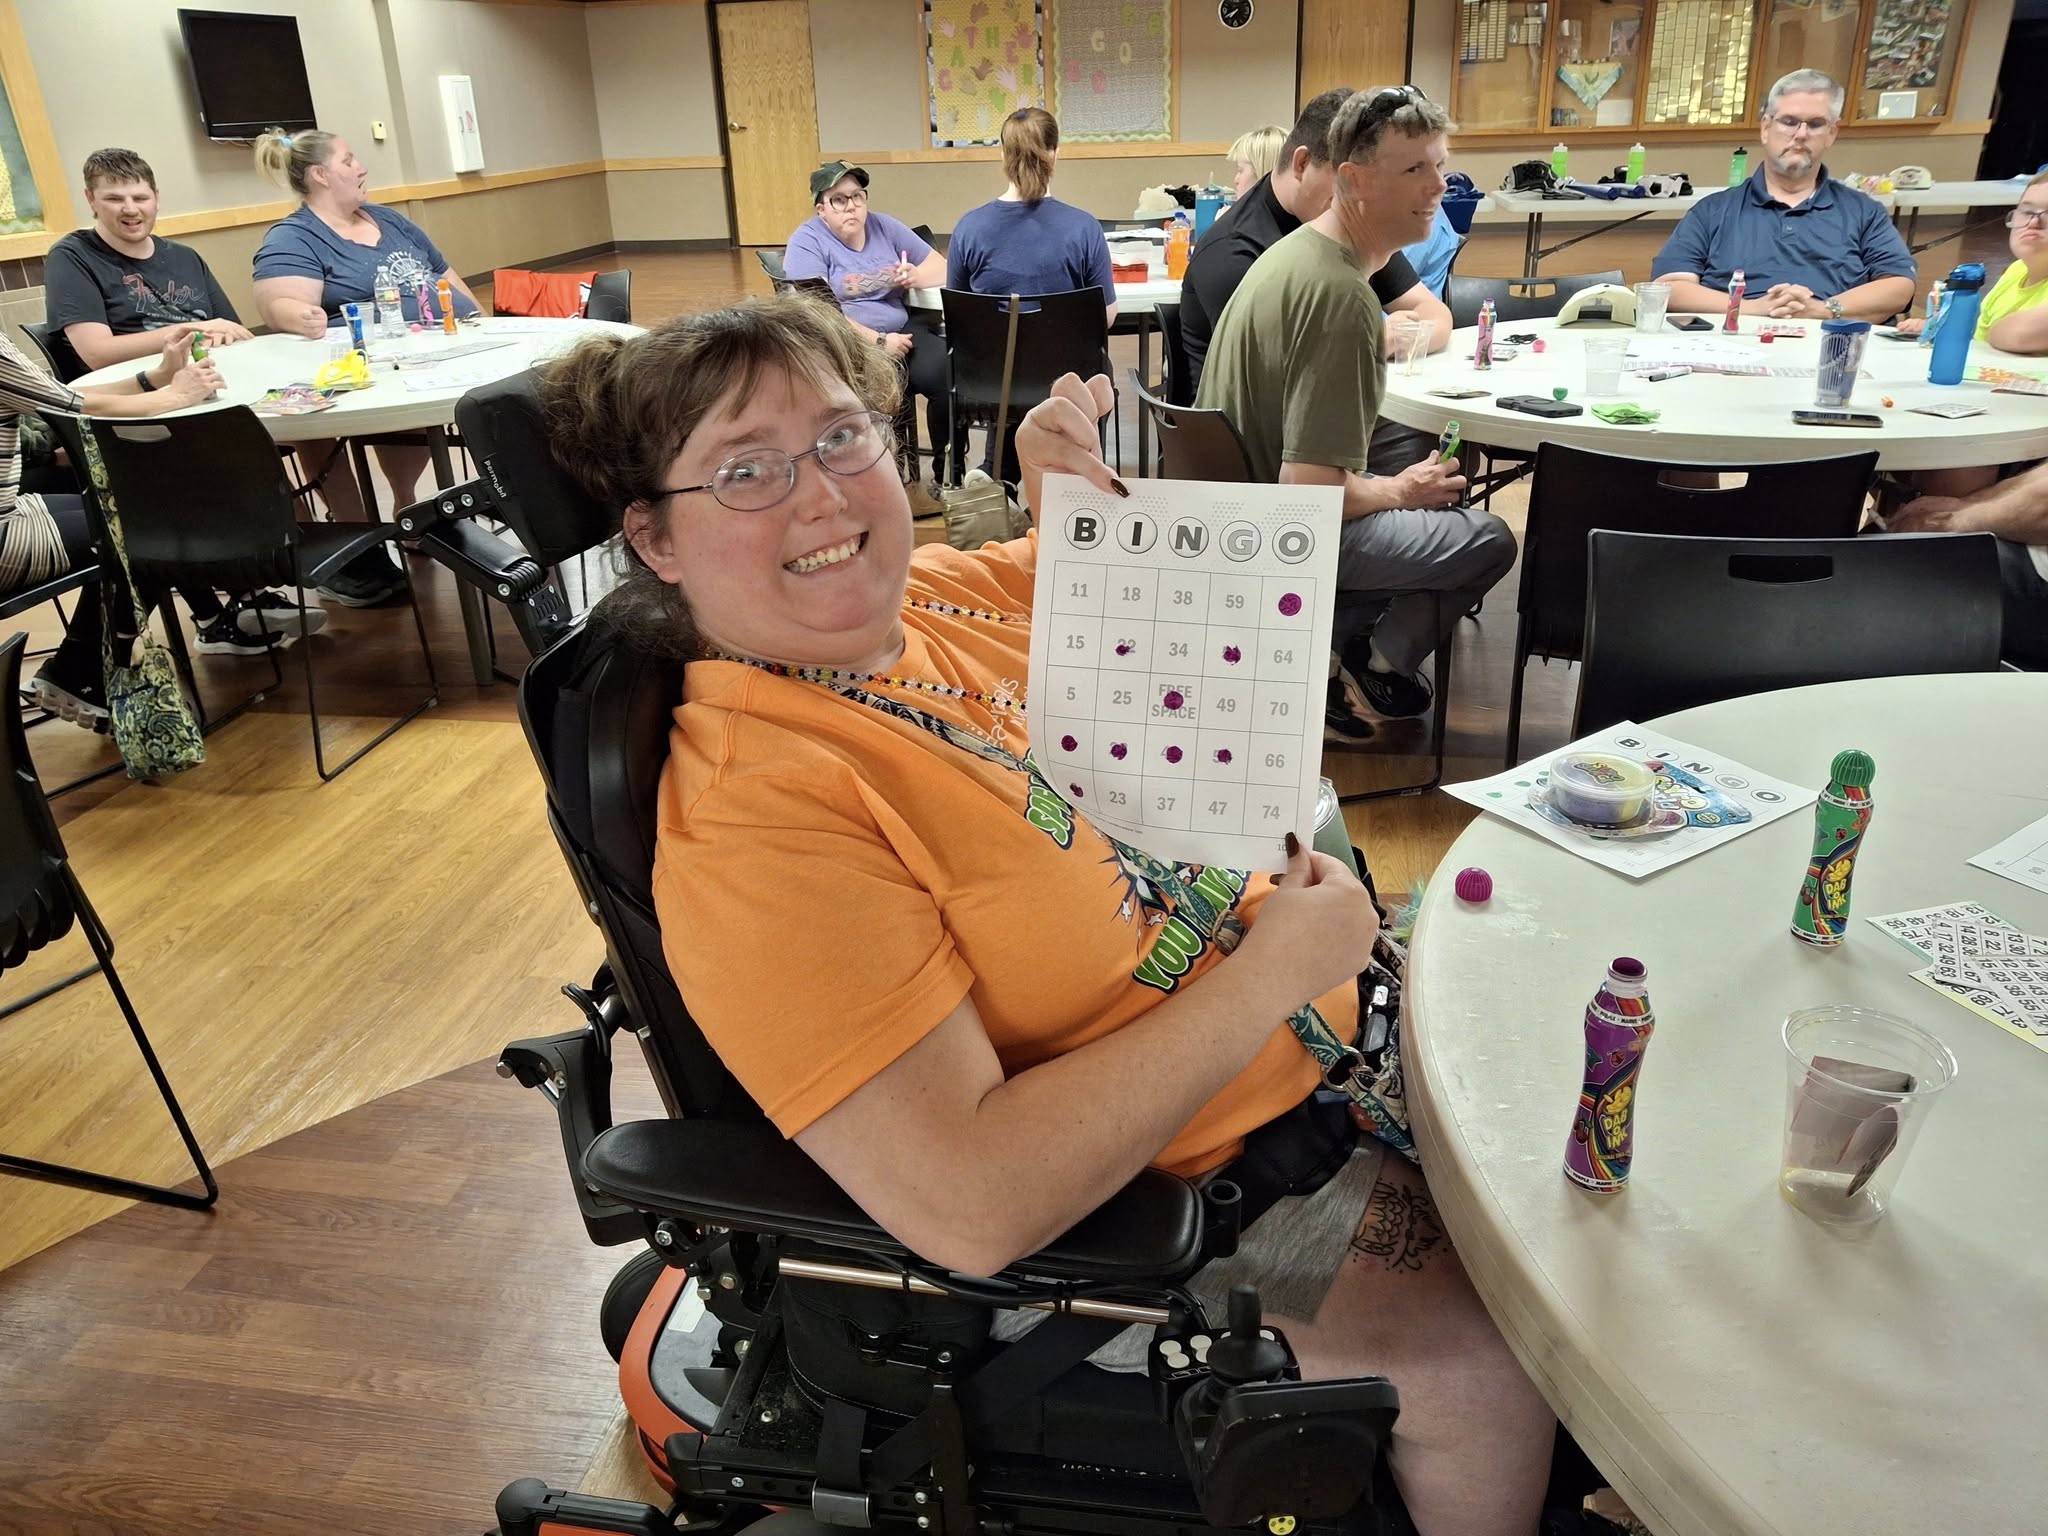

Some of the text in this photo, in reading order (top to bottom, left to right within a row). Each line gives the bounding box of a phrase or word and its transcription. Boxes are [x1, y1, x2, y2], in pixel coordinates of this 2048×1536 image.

[1070, 583, 1245, 610] 11 18 38 59
[1066, 634, 1085, 650] 15
[1168, 642, 1189, 658] 34
[1273, 649, 1294, 665] 64
[1066, 686, 1076, 701] 5
[1112, 690, 1132, 706] 25
[1216, 697, 1236, 713] 49
[1269, 701, 1290, 717] 70
[1264, 753, 1286, 769] 66
[1109, 790, 1281, 820] 23 37 47 74
[1825, 878, 1847, 894] DAB
[1827, 896, 1847, 912] INK
[1946, 908, 1965, 918] 18
[1886, 920, 1907, 929] 65
[1906, 917, 1926, 926] 48
[1901, 930, 1923, 940] 75
[1960, 924, 1977, 934] 14
[1938, 933, 1954, 942] 17
[1961, 935, 1978, 946] 28
[2007, 933, 2026, 956] 13 30
[2032, 938, 2048, 947] 7
[1938, 942, 1955, 954] 32
[1985, 939, 2002, 951] 22
[1133, 915, 1203, 990] YOU
[1939, 954, 1956, 966] 49
[2020, 958, 2041, 968] 14
[1940, 966, 1957, 978] 63
[2000, 958, 2048, 996] 12 20 43
[1978, 958, 1998, 969] 15
[1988, 971, 2012, 982] 23
[2004, 984, 2027, 997] 38
[2018, 999, 2042, 1011] 55
[1604, 1111, 1628, 1131] DAB
[1607, 1128, 1628, 1149] INK
